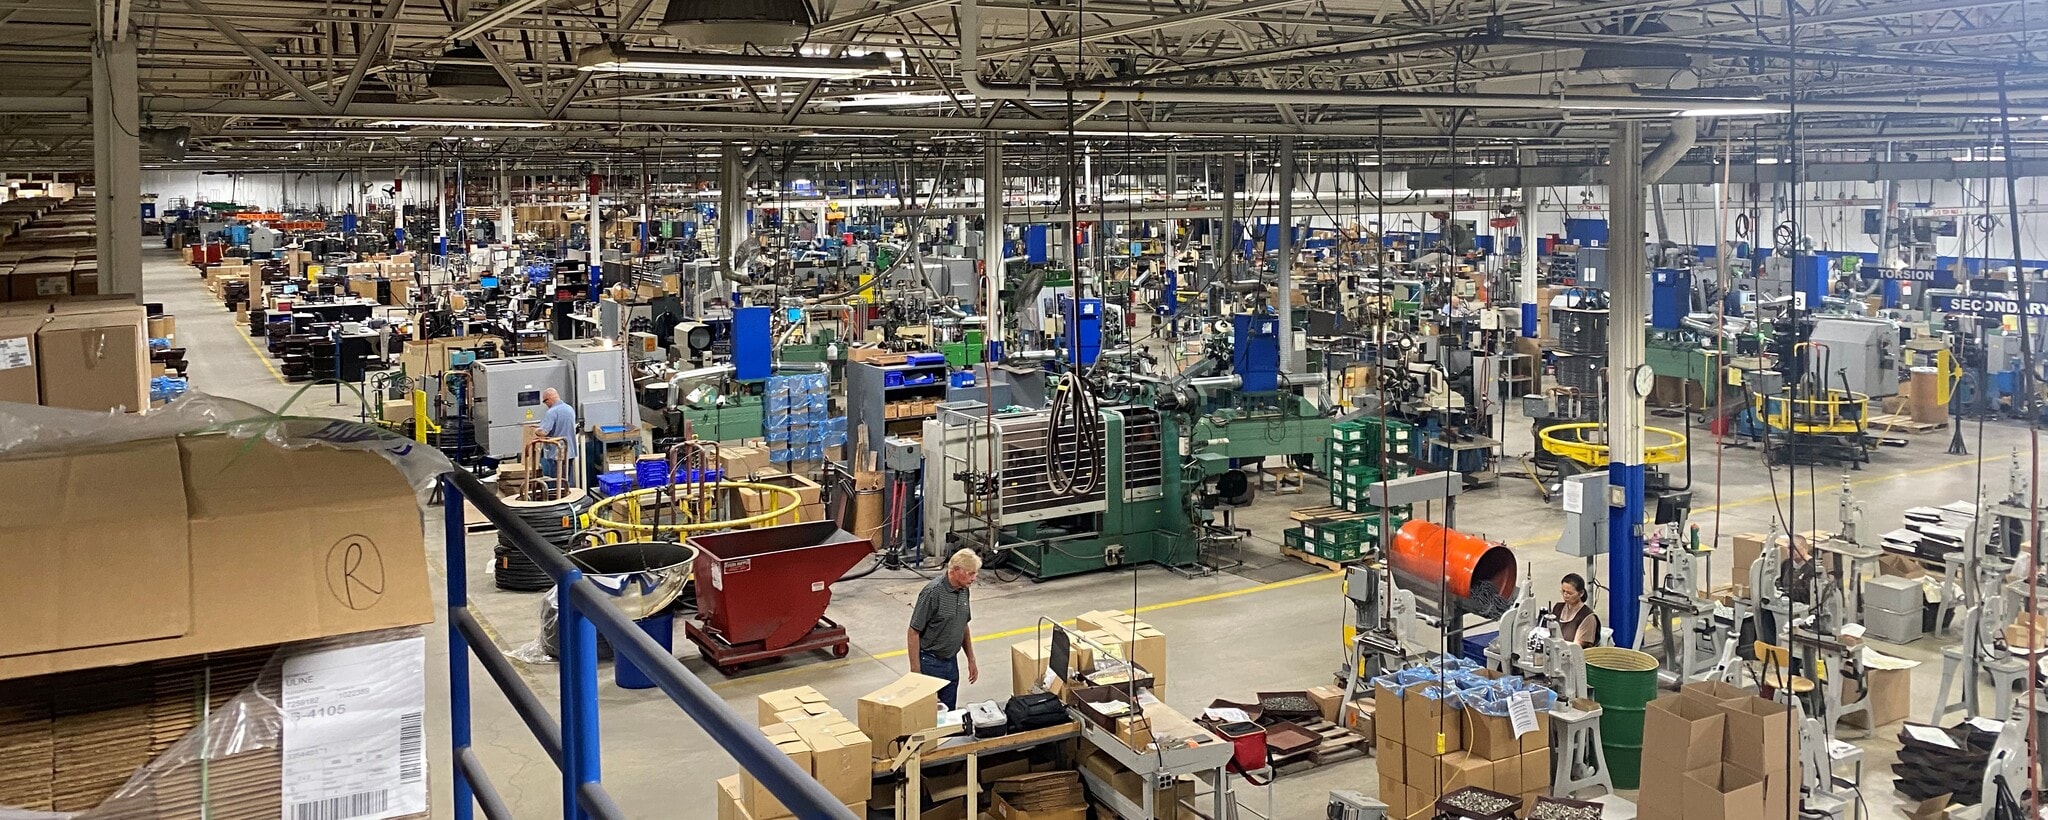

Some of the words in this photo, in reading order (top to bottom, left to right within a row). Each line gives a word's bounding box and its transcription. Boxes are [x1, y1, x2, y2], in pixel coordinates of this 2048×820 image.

[1878, 268, 1934, 281] TORSION
[1795, 296, 1801, 307] 3
[1951, 298, 2048, 316] SECONDRY
[286, 675, 314, 687] ULINE
